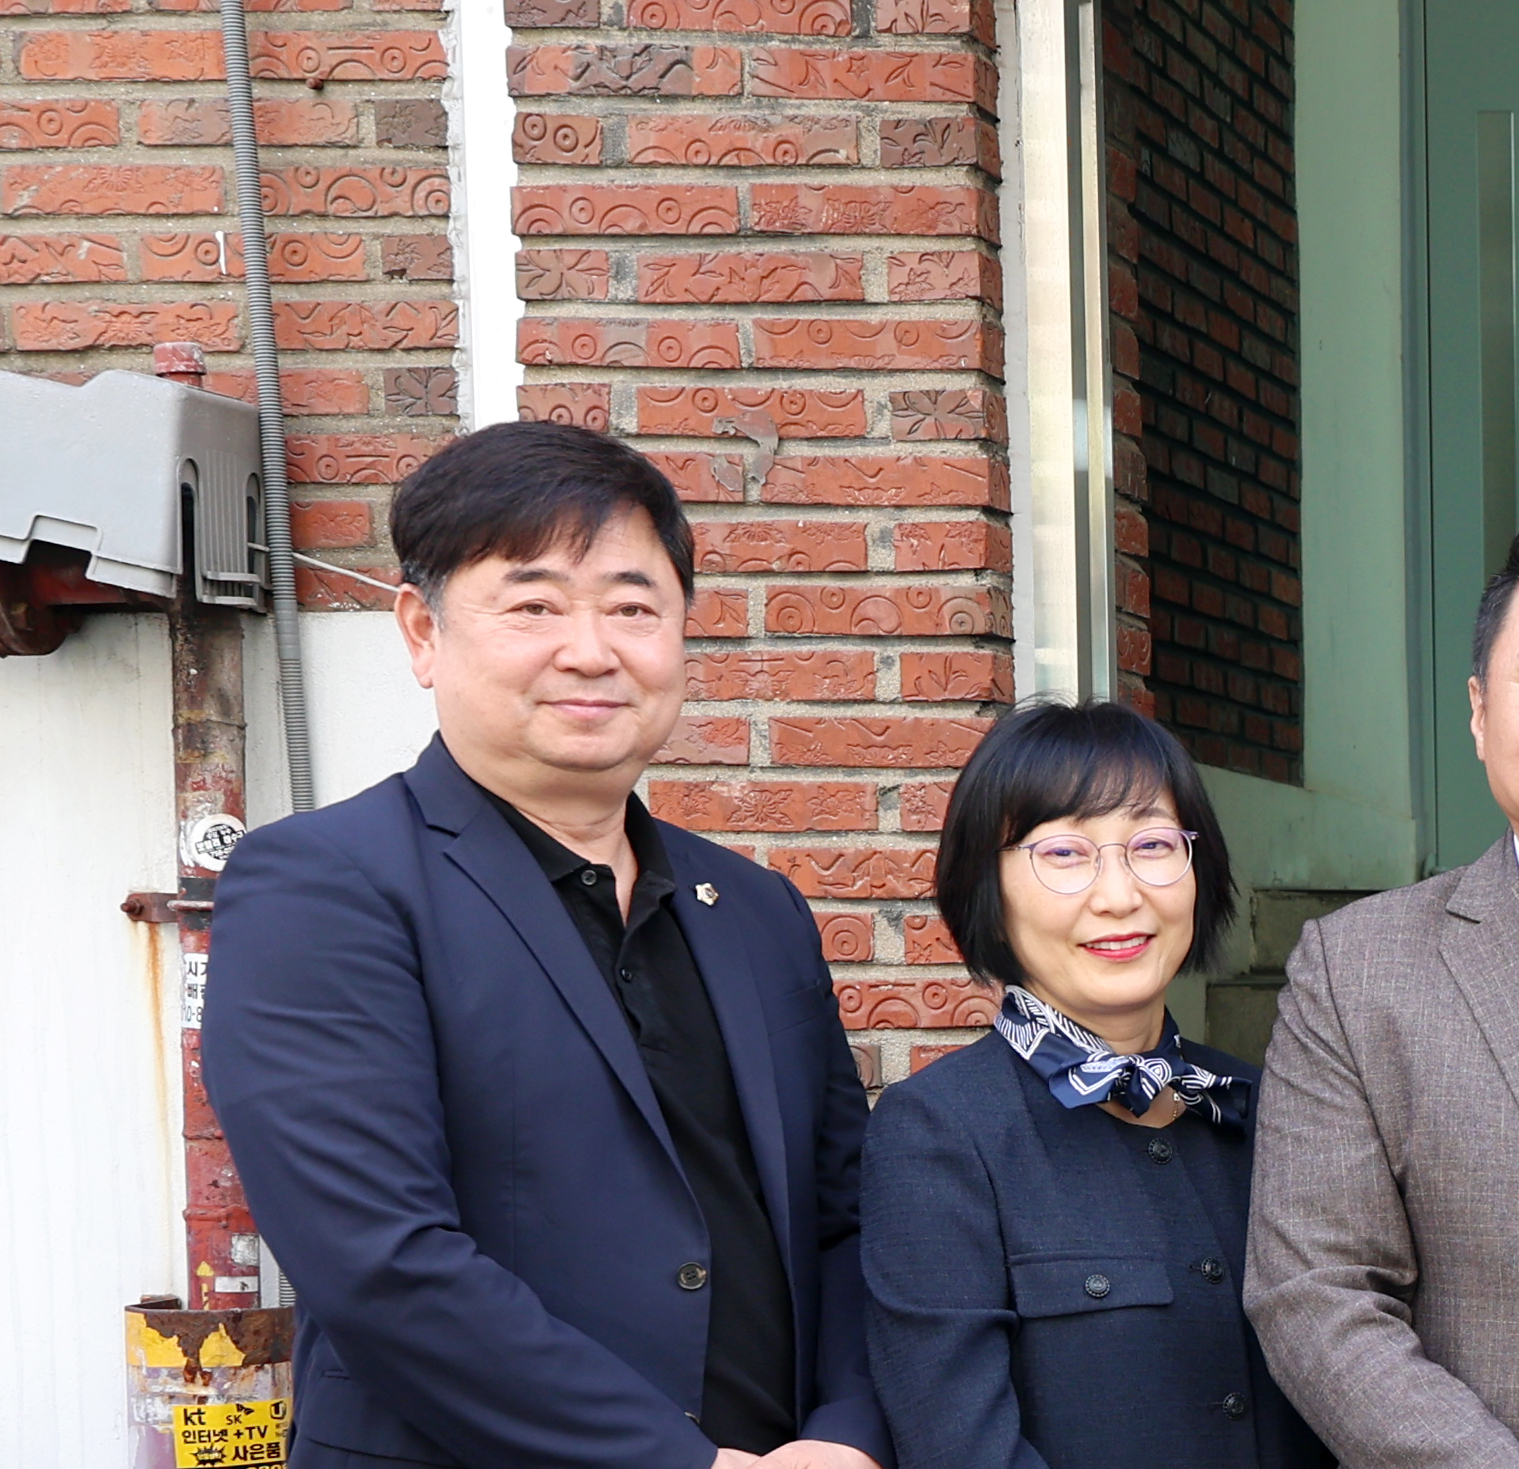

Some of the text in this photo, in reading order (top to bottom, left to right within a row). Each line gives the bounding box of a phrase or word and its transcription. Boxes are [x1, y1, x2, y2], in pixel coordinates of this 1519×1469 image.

[183, 1408, 206, 1426] kt
[226, 1414, 242, 1426] SK
[181, 1429, 229, 1445] 인터넷
[231, 1441, 281, 1462] 사은품
